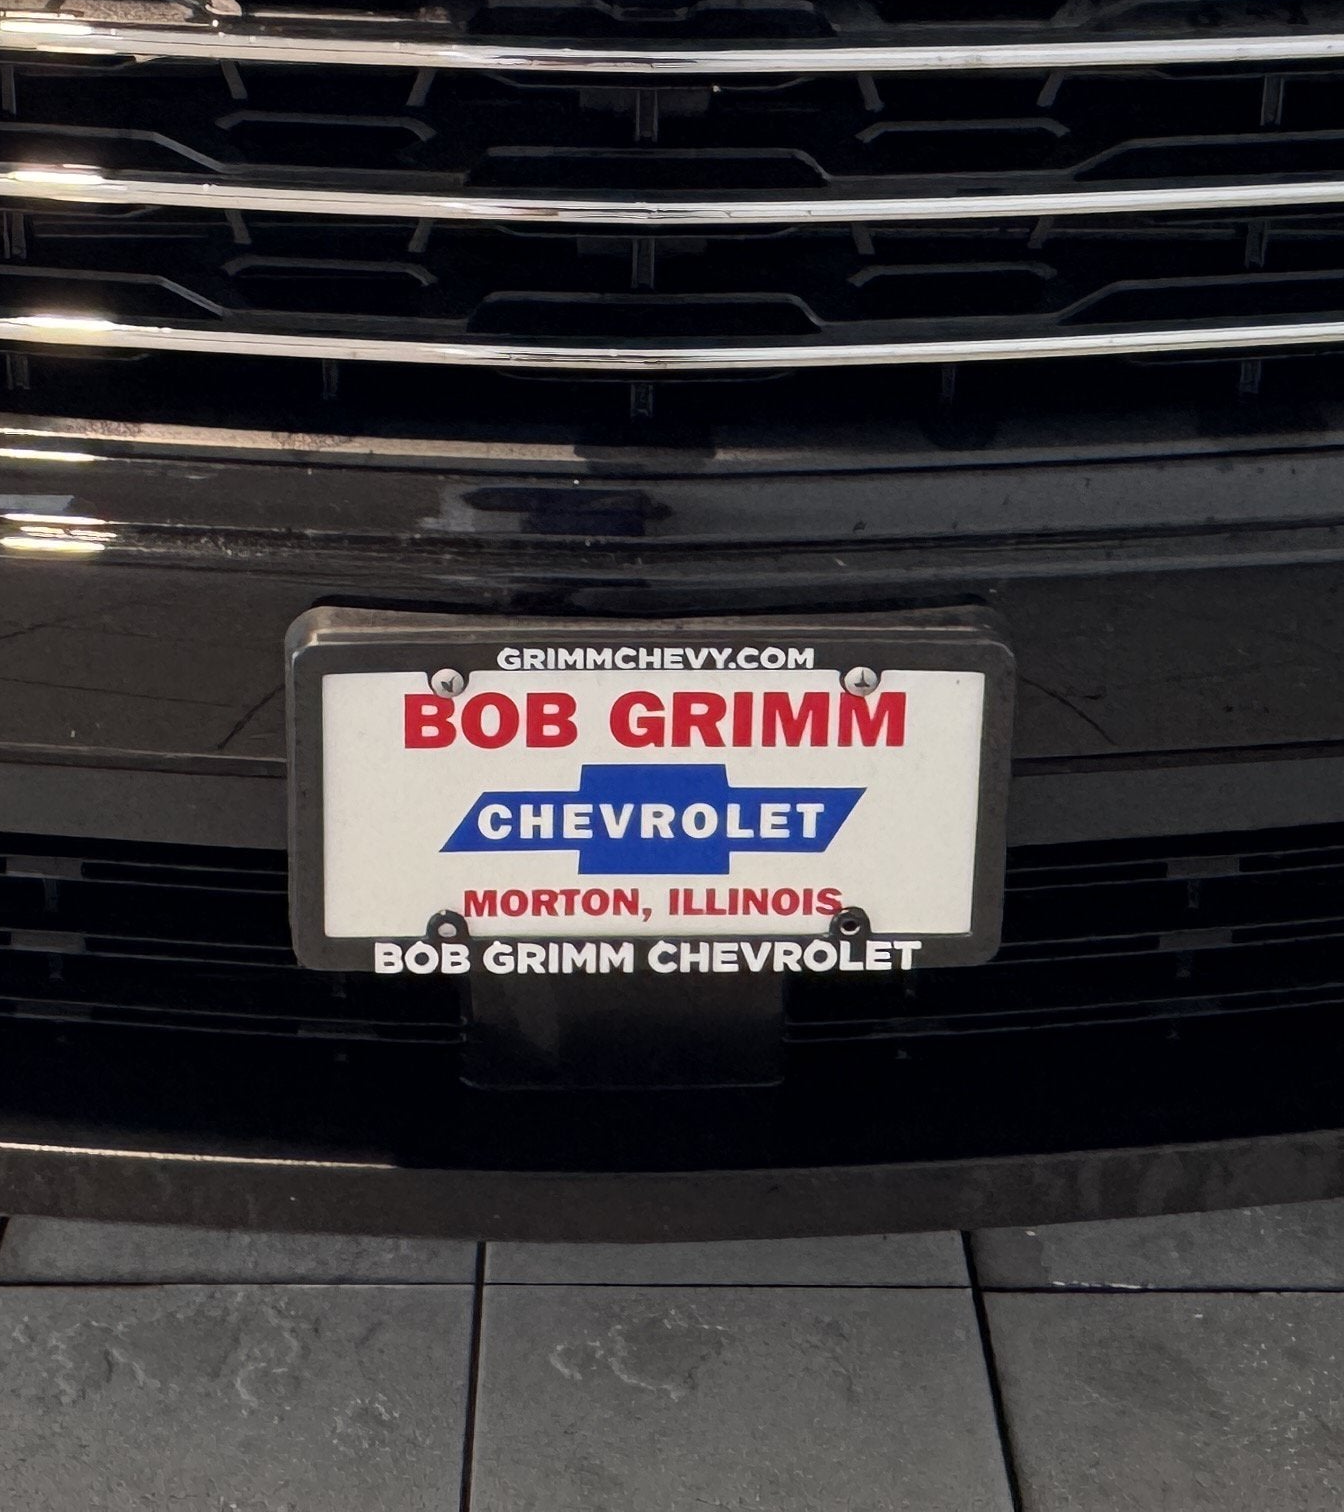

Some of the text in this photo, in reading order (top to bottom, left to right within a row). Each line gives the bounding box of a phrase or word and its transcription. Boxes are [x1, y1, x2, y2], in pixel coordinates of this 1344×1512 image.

[496, 646, 815, 671] GRIMMCHEVY.COM
[404, 690, 907, 749] BOB GRIMM
[477, 803, 825, 840] CHEVROLET
[463, 887, 843, 922] MORTON, ILLINOIS
[374, 939, 922, 975] BOB GRIMM CHEVROLET
